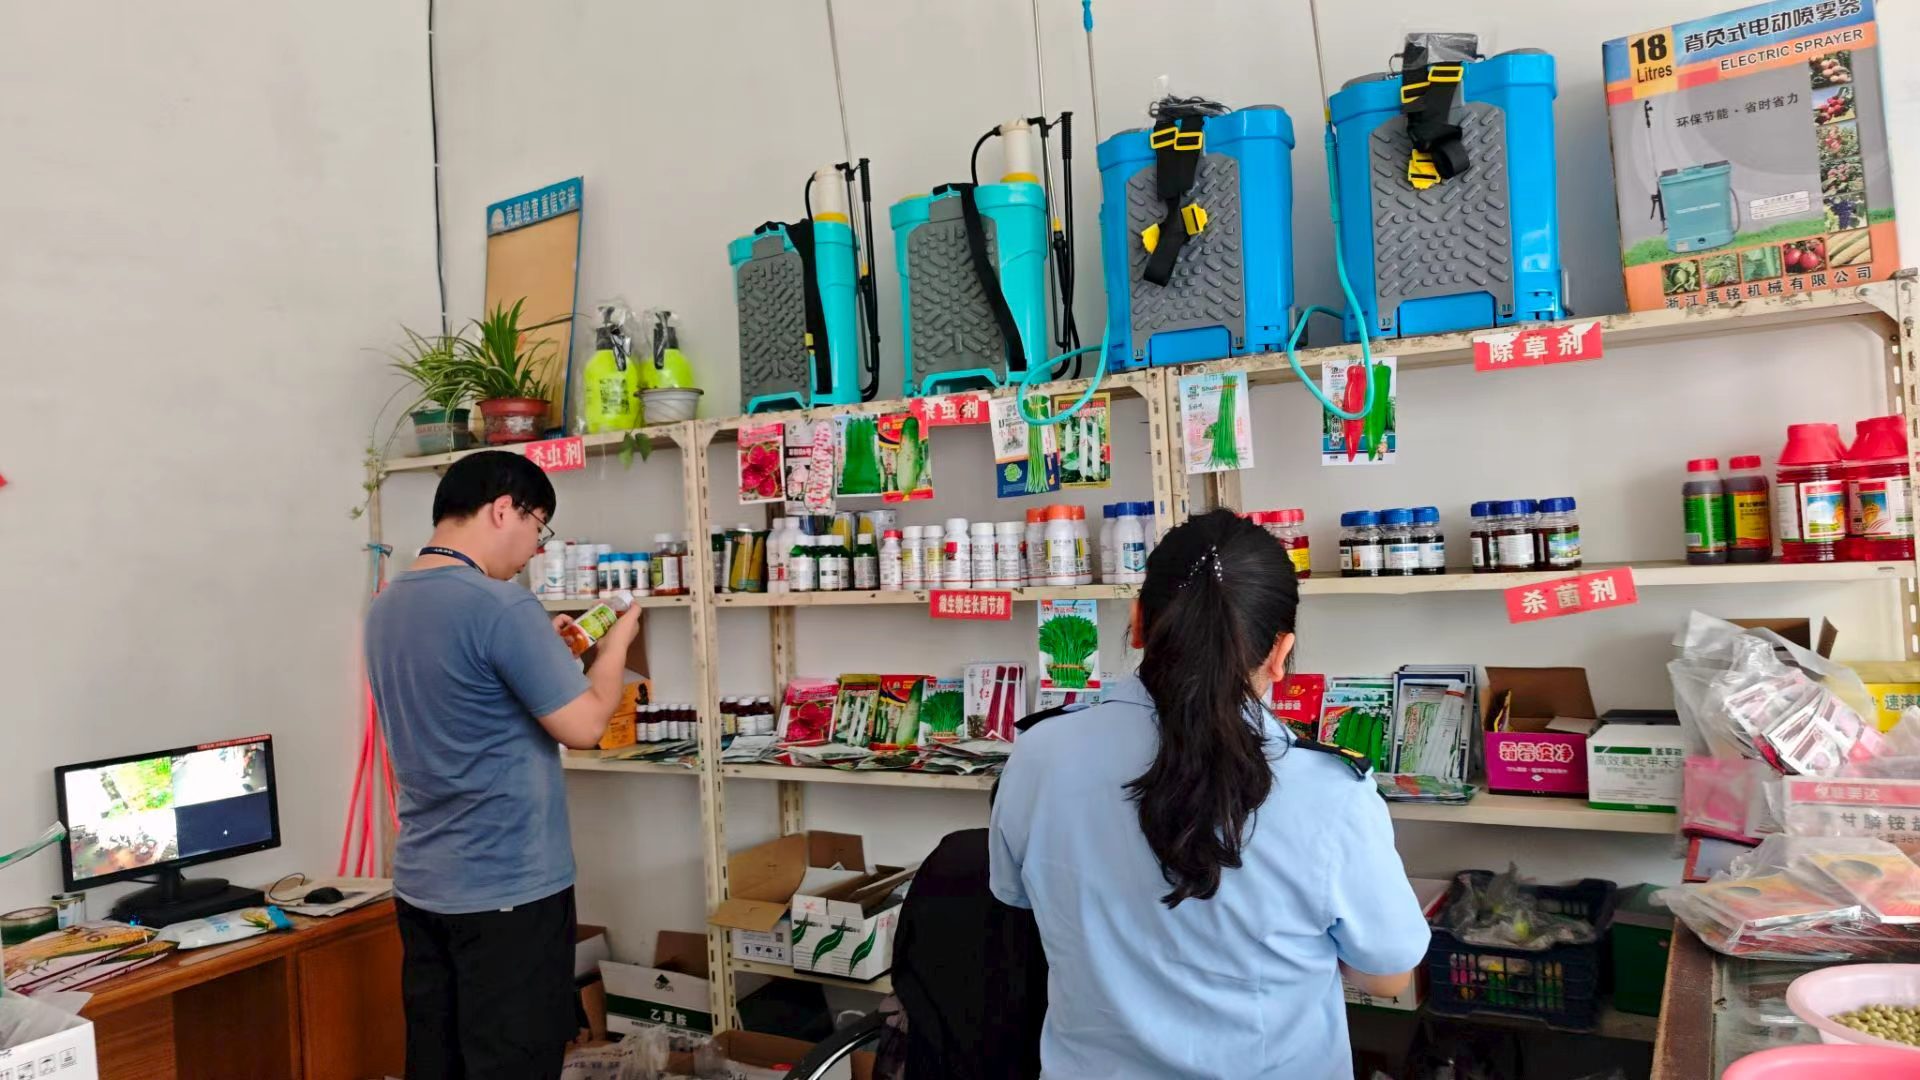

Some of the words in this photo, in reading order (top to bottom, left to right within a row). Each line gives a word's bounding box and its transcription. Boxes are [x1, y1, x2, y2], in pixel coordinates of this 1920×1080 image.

[1631, 34, 1667, 64] 18
[1720, 45, 1790, 71] ELECTRIC
[1794, 28, 1864, 53] SPRAYER
[1637, 64, 1673, 83] Litres
[1489, 331, 1584, 364] 除草剂
[530, 441, 583, 470] 杀虫剂
[1522, 576, 1617, 614] 杀菌剂
